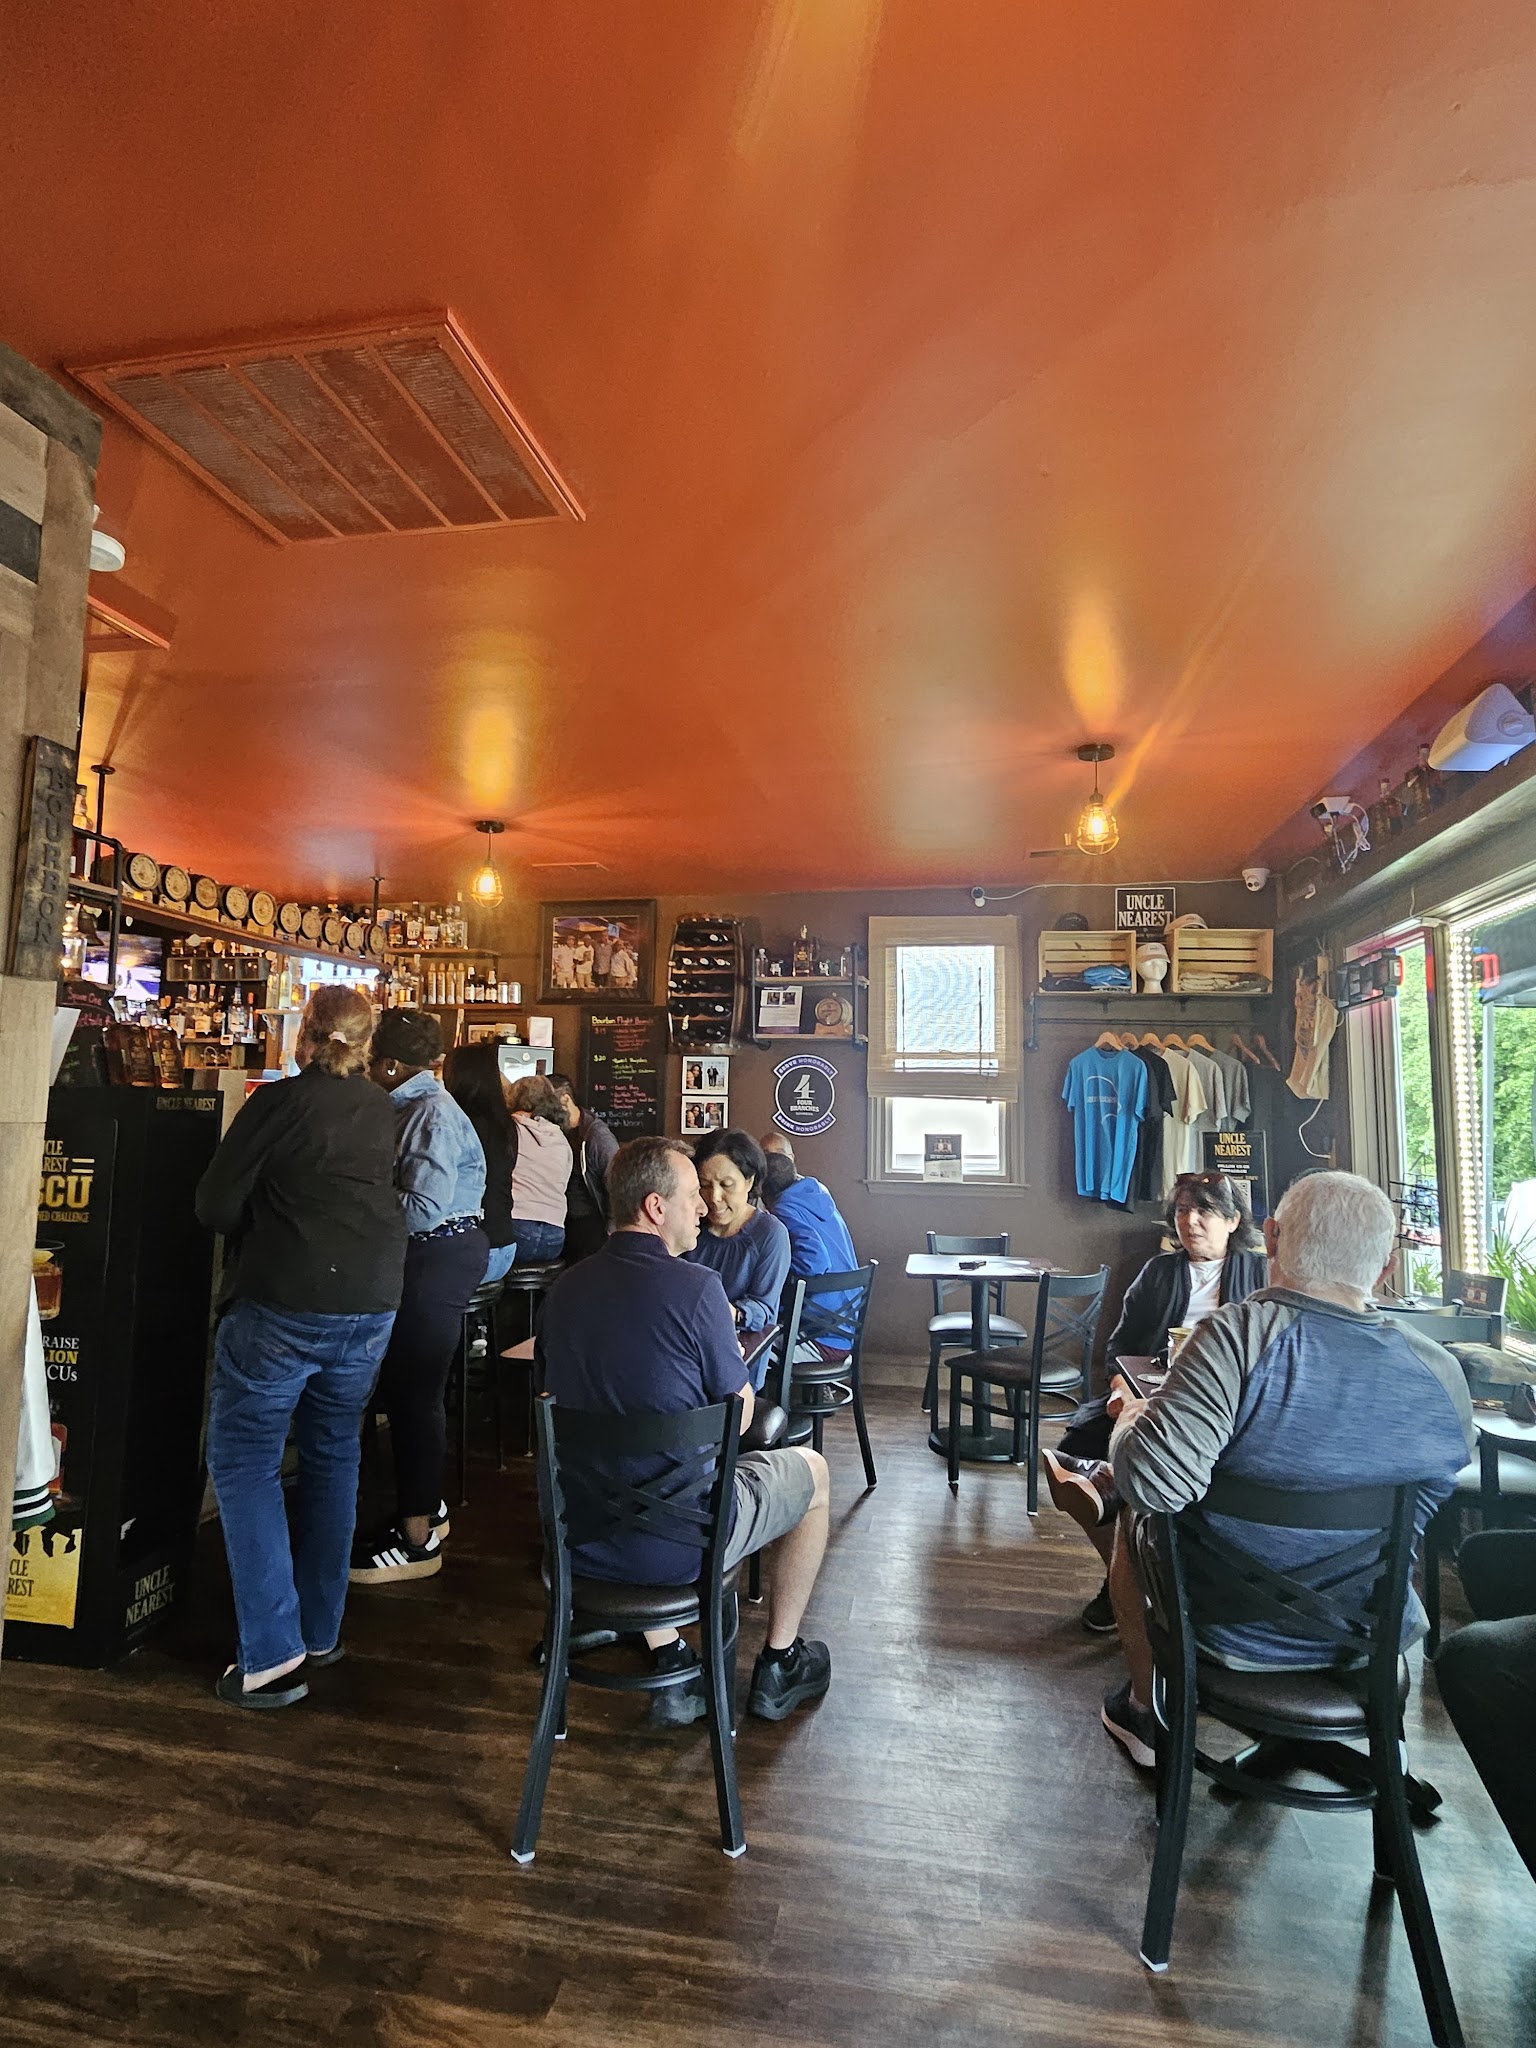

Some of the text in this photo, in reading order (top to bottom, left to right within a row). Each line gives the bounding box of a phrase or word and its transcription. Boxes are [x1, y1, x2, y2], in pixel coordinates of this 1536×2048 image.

[34, 766, 64, 944] BOURBON
[1126, 895, 1164, 910] UNCLE
[1119, 911, 1172, 927] NEAREST
[591, 1016, 616, 1025] Bourbon
[778, 1058, 834, 1075] SERVE HONORABLY
[793, 1074, 815, 1099] 4
[183, 1097, 217, 1111] NEAREST
[777, 1115, 832, 1132] DRINK HONORABLY
[1219, 1133, 1246, 1144] UNCLE
[46, 1140, 63, 1155] CLE
[1214, 1145, 1252, 1156] NEAREST
[43, 1157, 69, 1172] REST
[39, 1175, 93, 1208] CU
[42, 1336, 79, 1349] RAISE
[47, 1364, 77, 1382] CUs
[9, 1559, 29, 1576] CLE
[6, 1577, 35, 1597] REST
[135, 1564, 170, 1601] UNCLE
[125, 1582, 175, 1628] NEAREST
